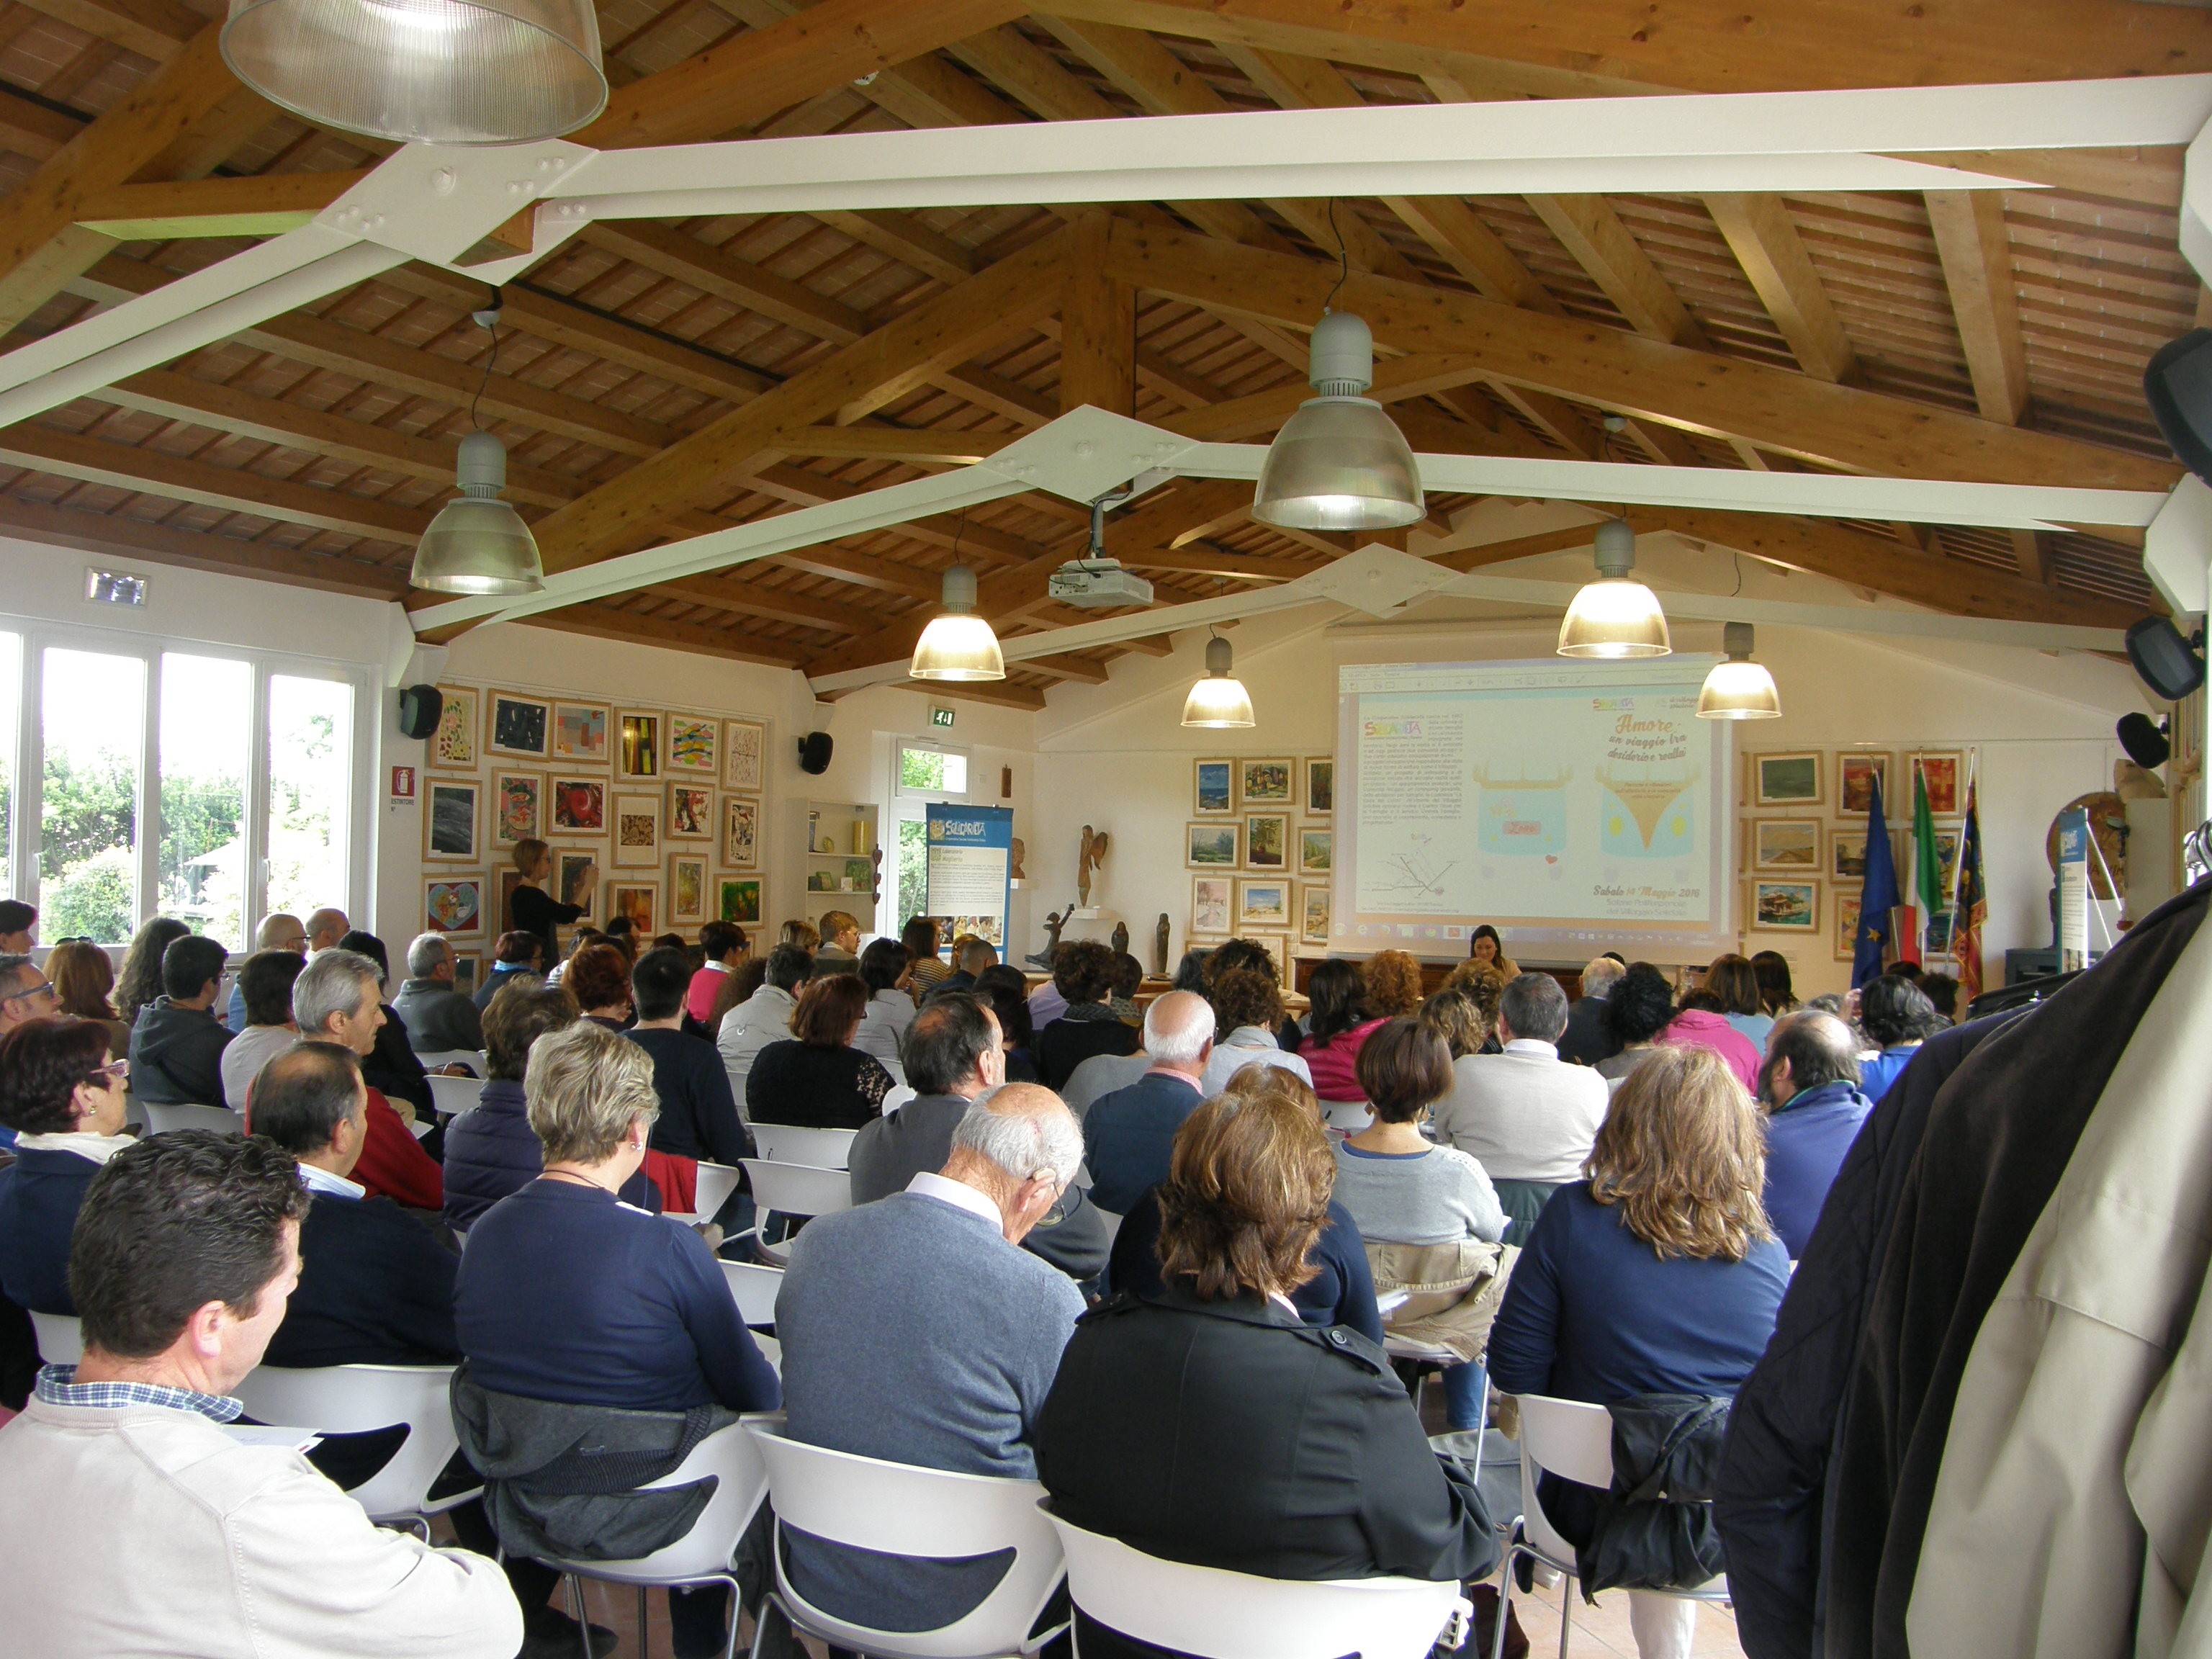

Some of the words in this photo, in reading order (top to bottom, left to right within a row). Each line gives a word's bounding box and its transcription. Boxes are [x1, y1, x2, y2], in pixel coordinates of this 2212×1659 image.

[1626, 736, 1666, 749] viaggio
[1607, 747, 1649, 761] desiderio
[1638, 886, 1676, 899] Maggio
[1678, 889, 1700, 898] 2016
